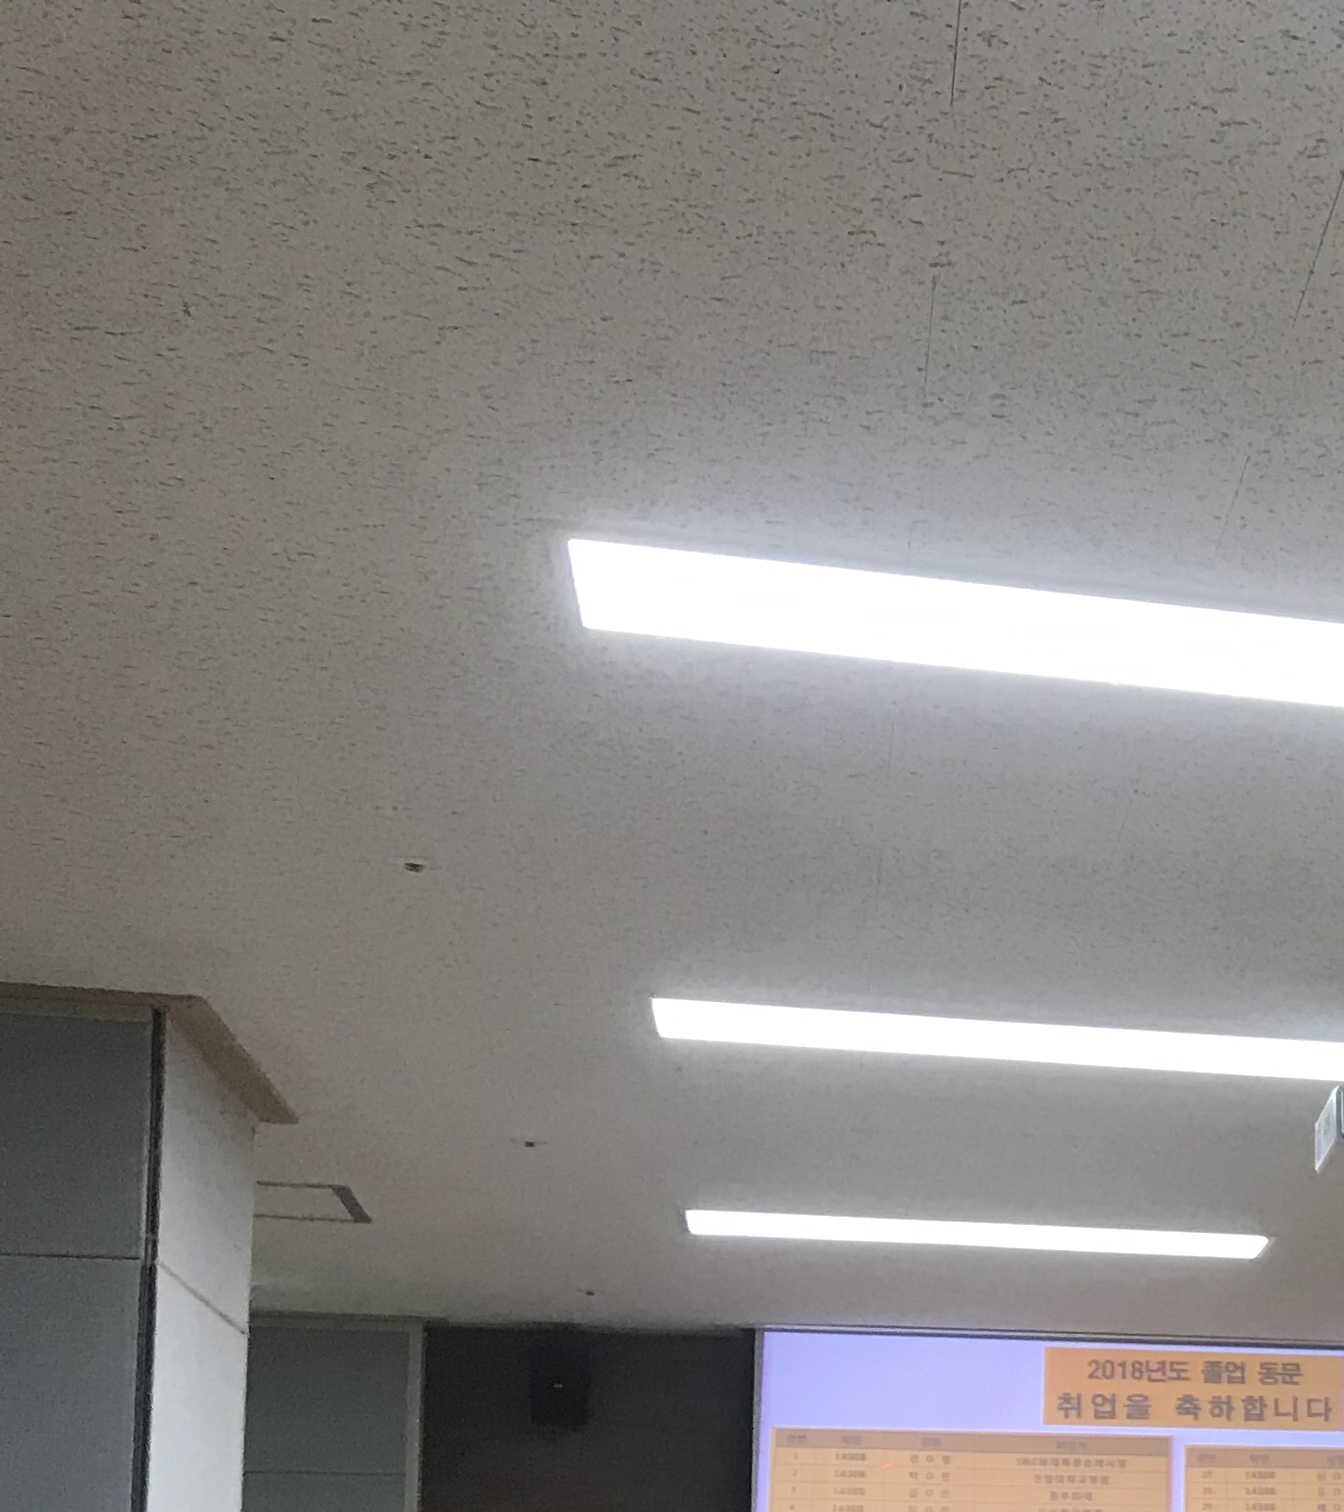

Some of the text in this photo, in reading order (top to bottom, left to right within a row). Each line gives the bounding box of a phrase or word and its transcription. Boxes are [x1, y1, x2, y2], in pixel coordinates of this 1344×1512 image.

[1087, 1359, 1304, 1386] 2018년도 졸업 동문
[1057, 1393, 1333, 1423] 취업을 축하합니다
